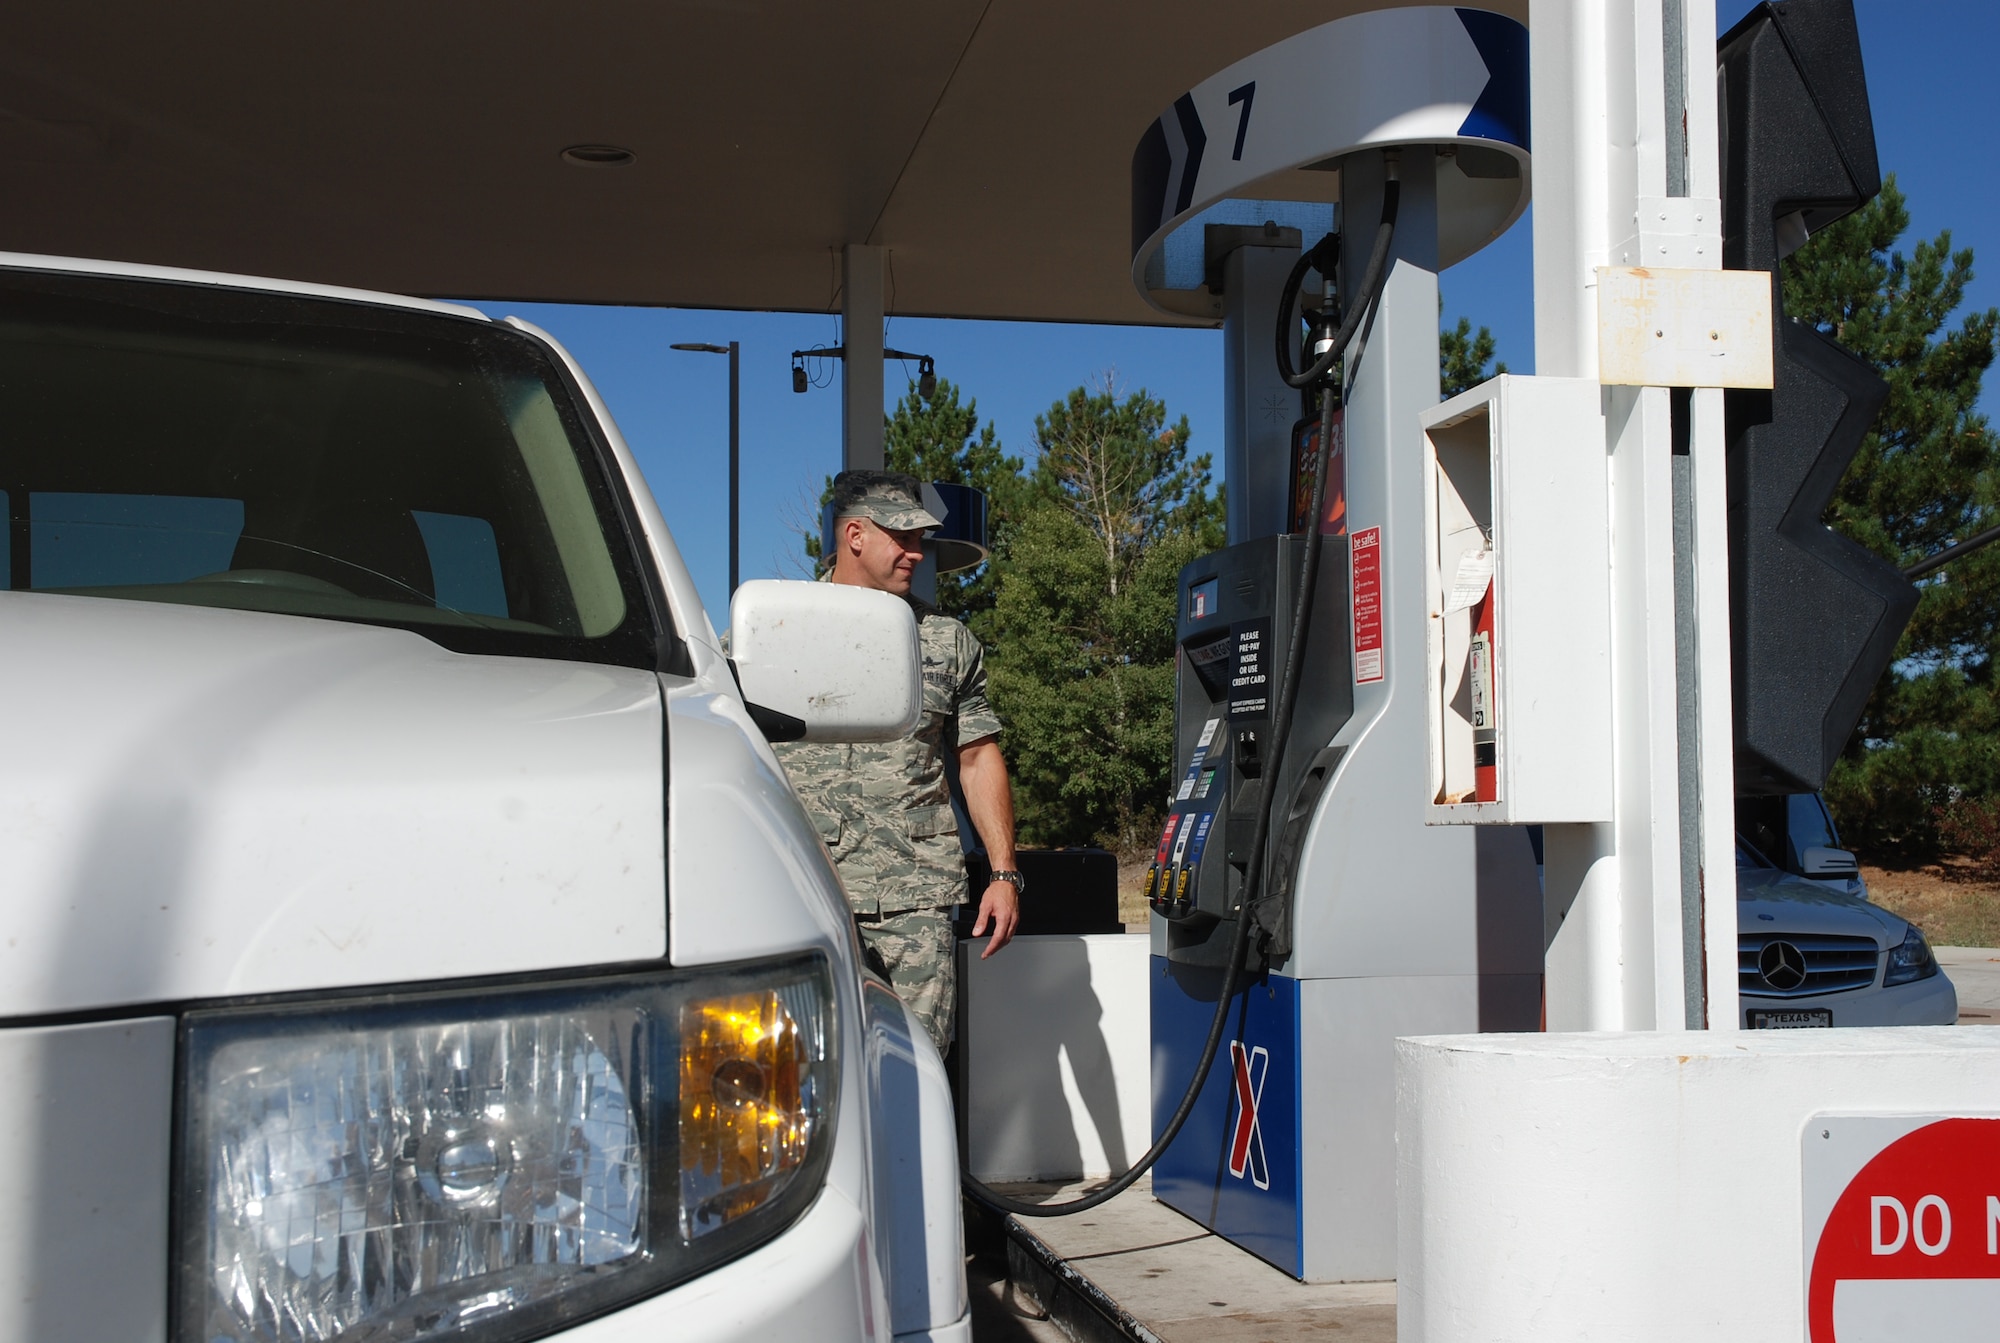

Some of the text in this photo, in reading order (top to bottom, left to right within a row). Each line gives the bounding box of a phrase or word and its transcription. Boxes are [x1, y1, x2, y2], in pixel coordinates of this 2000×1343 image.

[1228, 80, 1256, 161] 7
[1354, 532, 1376, 549] be safe!
[1240, 631, 1259, 641] PLEASE
[1239, 642, 1260, 652] PRE-PAY
[1240, 653, 1257, 663] INSIDE
[1239, 665, 1258, 674] OR USE
[1232, 675, 1266, 687] CREDIT CARD
[1774, 1013, 1810, 1022] TEXAS
[1870, 1194, 1952, 1256] DO
